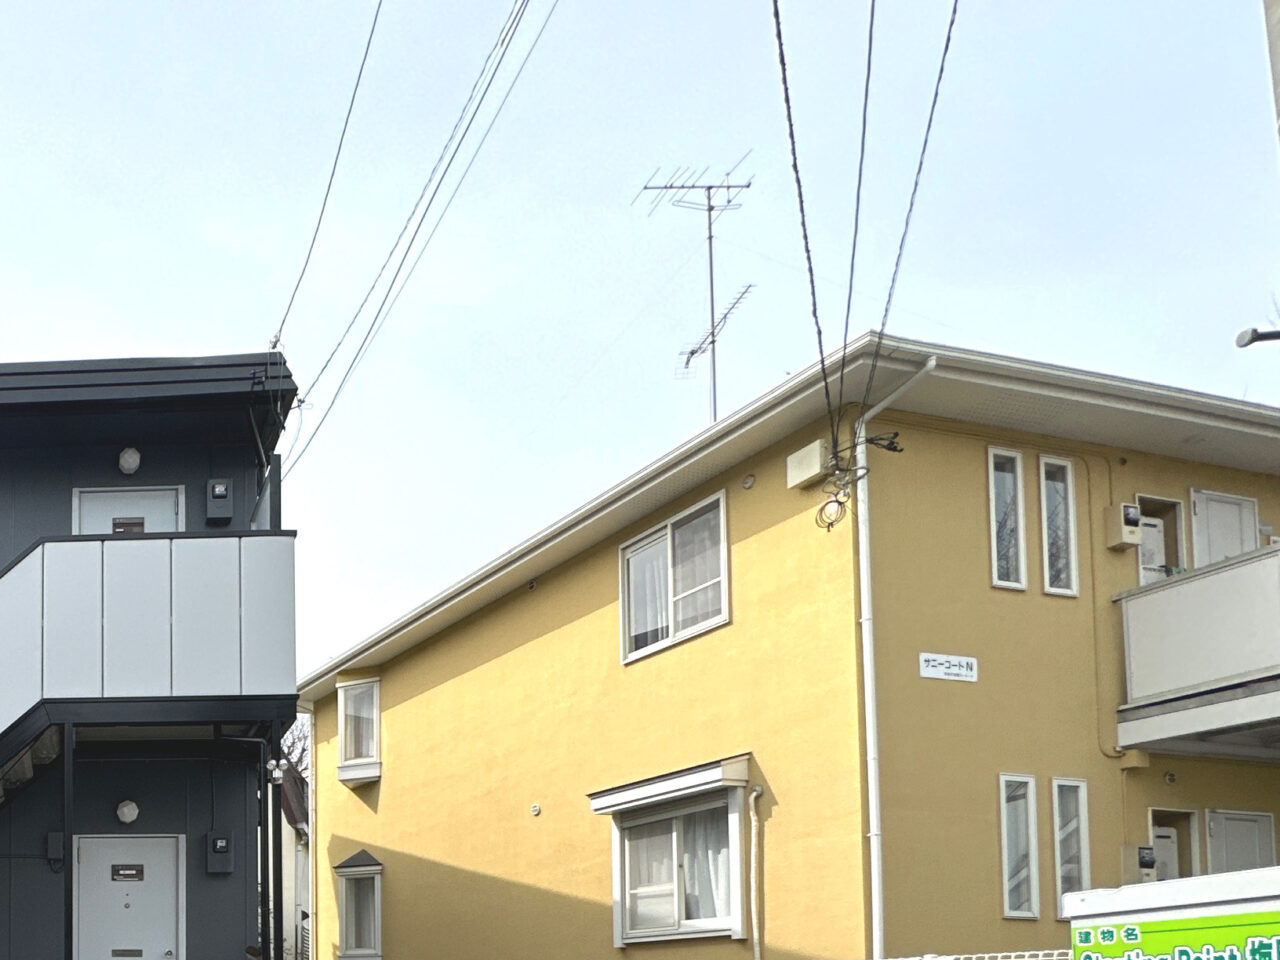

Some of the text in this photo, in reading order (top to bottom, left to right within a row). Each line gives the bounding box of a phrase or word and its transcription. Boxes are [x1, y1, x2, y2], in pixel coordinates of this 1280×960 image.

[924, 658, 974, 672] サニーコートN
[1078, 928, 1138, 943] 建物名
